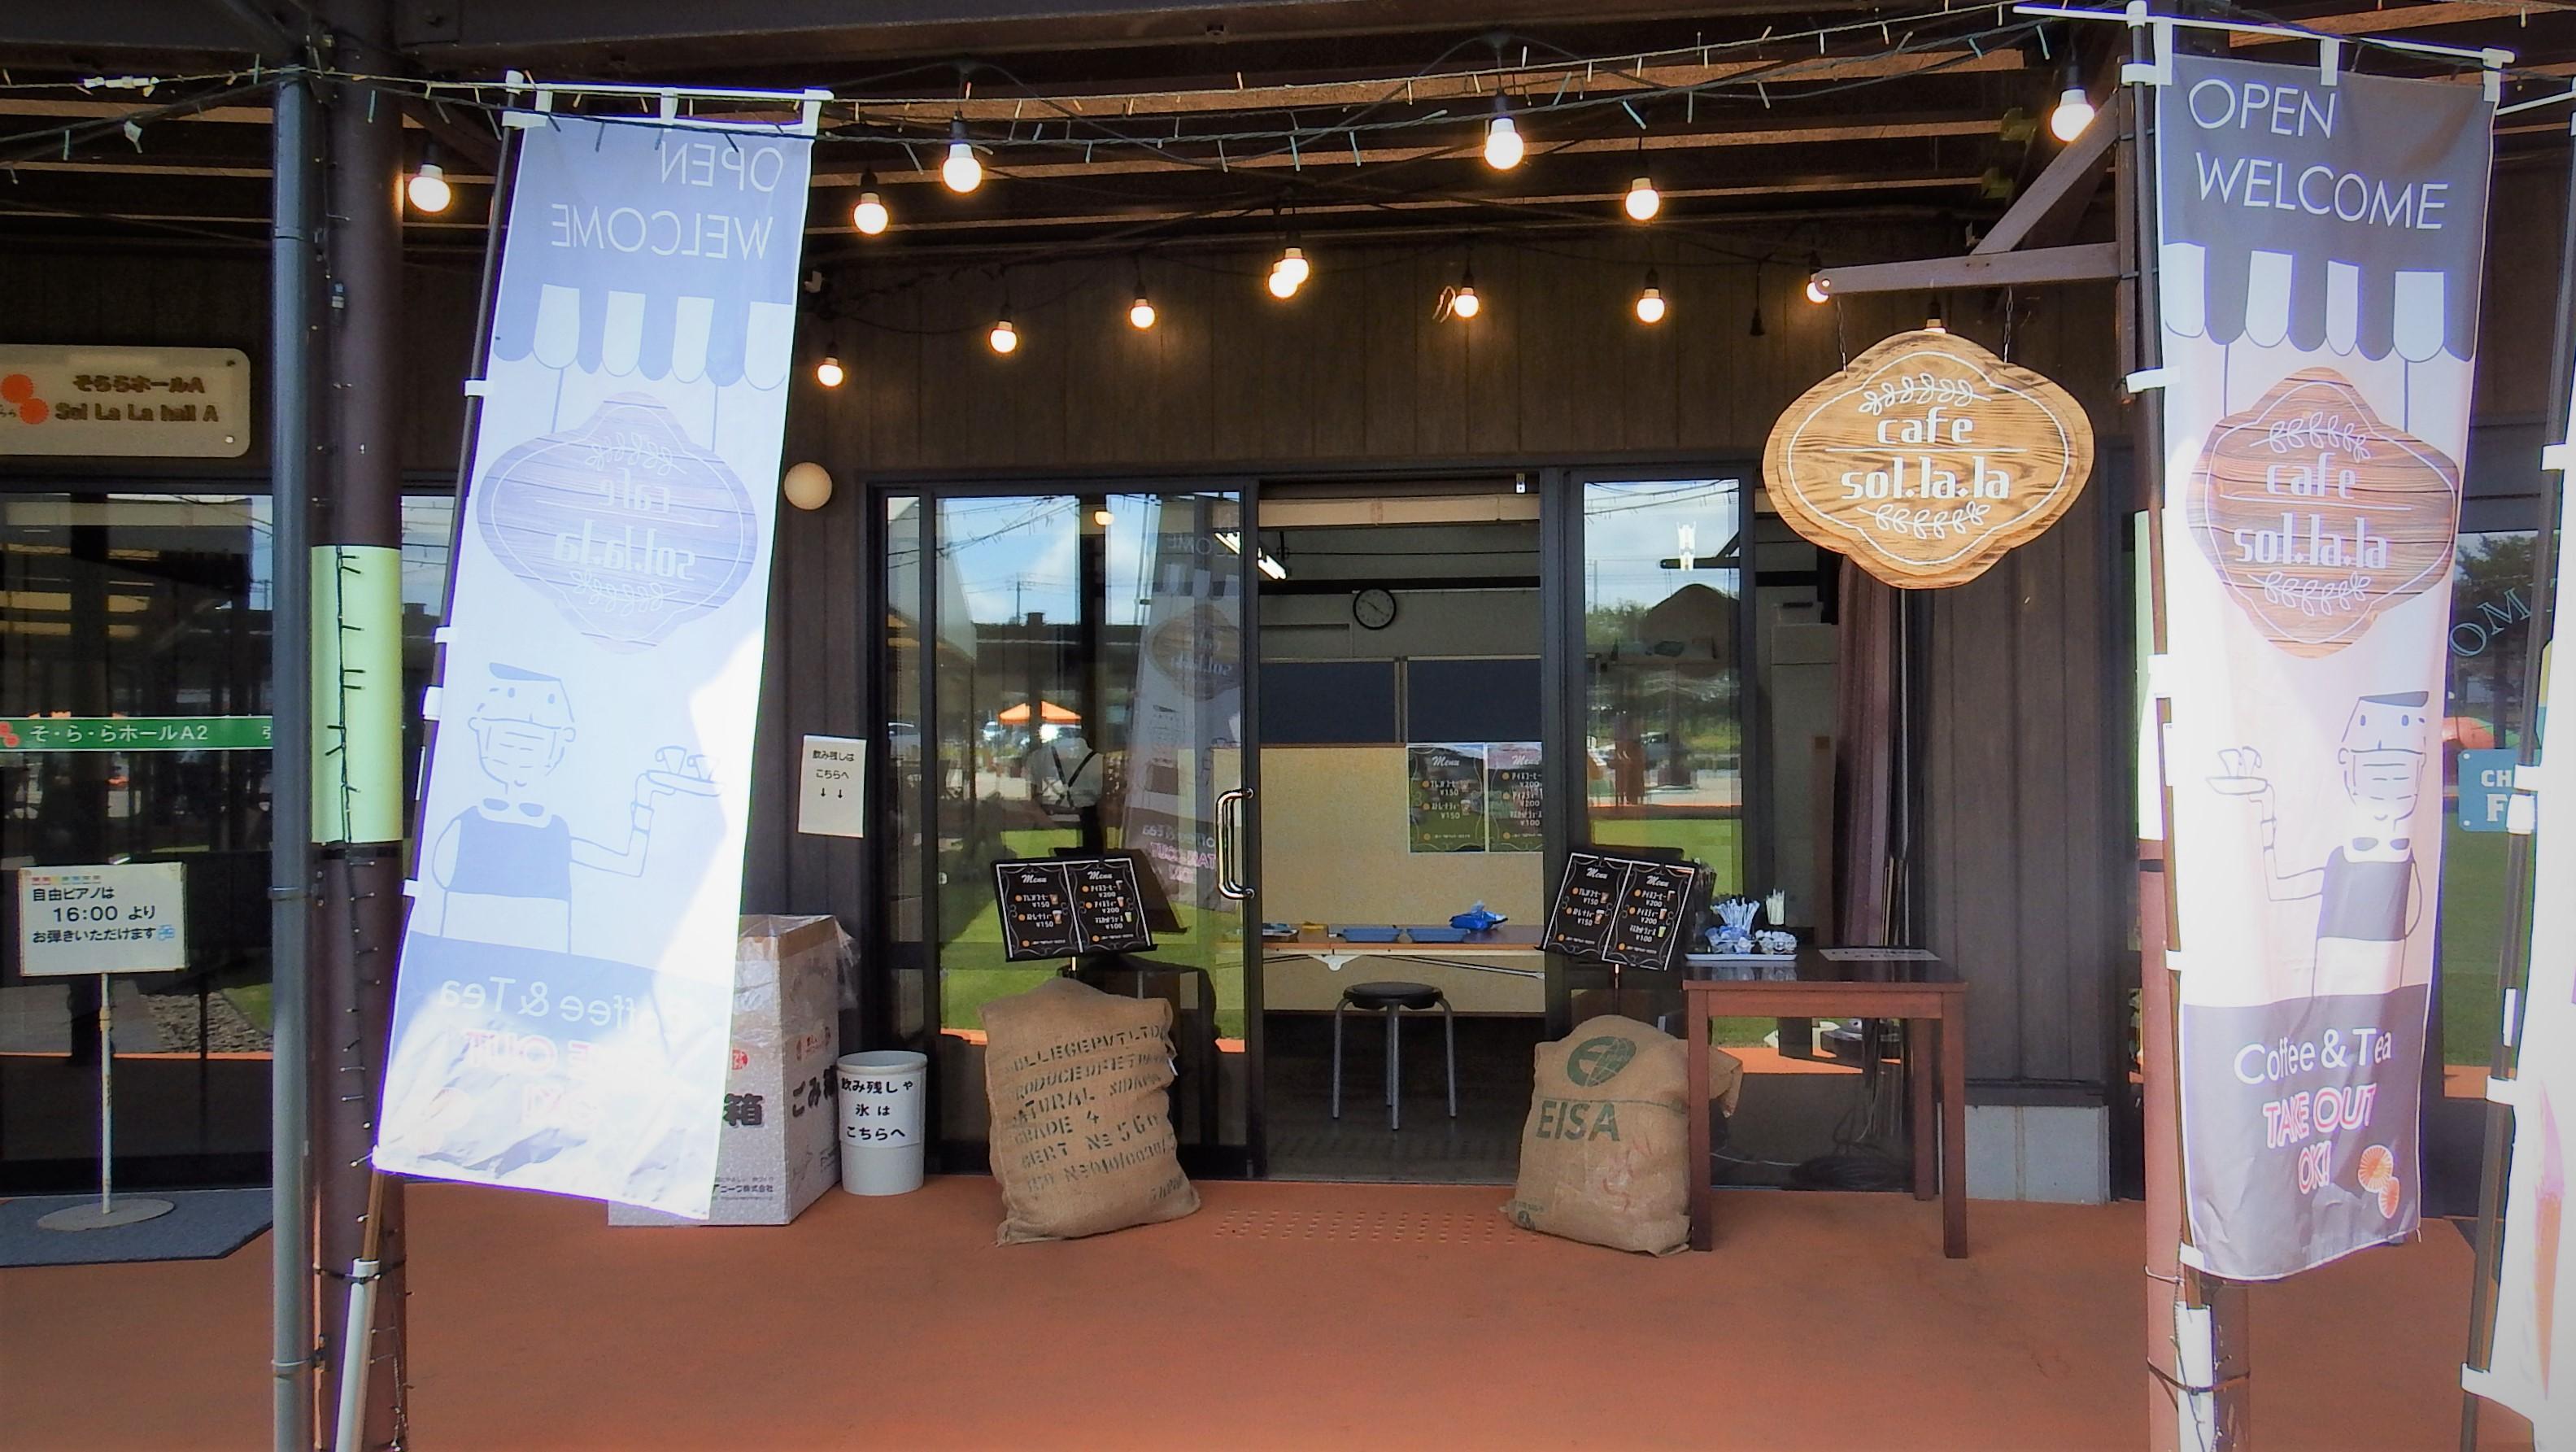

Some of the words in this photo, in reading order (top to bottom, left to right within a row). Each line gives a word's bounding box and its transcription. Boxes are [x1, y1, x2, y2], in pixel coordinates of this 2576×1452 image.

[2188, 79, 2337, 139] OPEN
[2195, 152, 2448, 230] WELCOME
[94, 404, 120, 421] La
[128, 404, 154, 421] La
[203, 405, 219, 422] A
[1877, 407, 1974, 444] cafe
[1841, 456, 2010, 499] sol.la.la
[2266, 452, 2356, 499] cafe
[2234, 512, 2387, 569] sol.la.la
[1432, 756, 1460, 766] Menu
[816, 769, 850, 780] こちらへ
[2481, 769, 2513, 787] CH
[2487, 793, 2508, 822] F
[1021, 874, 1047, 883] Menu
[1087, 870, 1113, 880] Menu
[33, 887, 115, 902] 自由ピアノは
[52, 905, 119, 922] 16:00
[128, 904, 156, 920] より
[33, 927, 156, 944] お弾きいただけます
[2234, 1036, 2316, 1084] Coffee
[2321, 1028, 2347, 1068] &
[2352, 1027, 2391, 1067] Tea
[855, 1103, 891, 1118] 氷は
[1087, 1110, 1099, 1124] 4
[2263, 1091, 2310, 1149] TAKE
[2312, 1083, 2377, 1133] OUT
[1536, 1100, 1620, 1141] EISA
[846, 1125, 906, 1140] こちらへ
[2298, 1140, 2332, 1195] OK!
